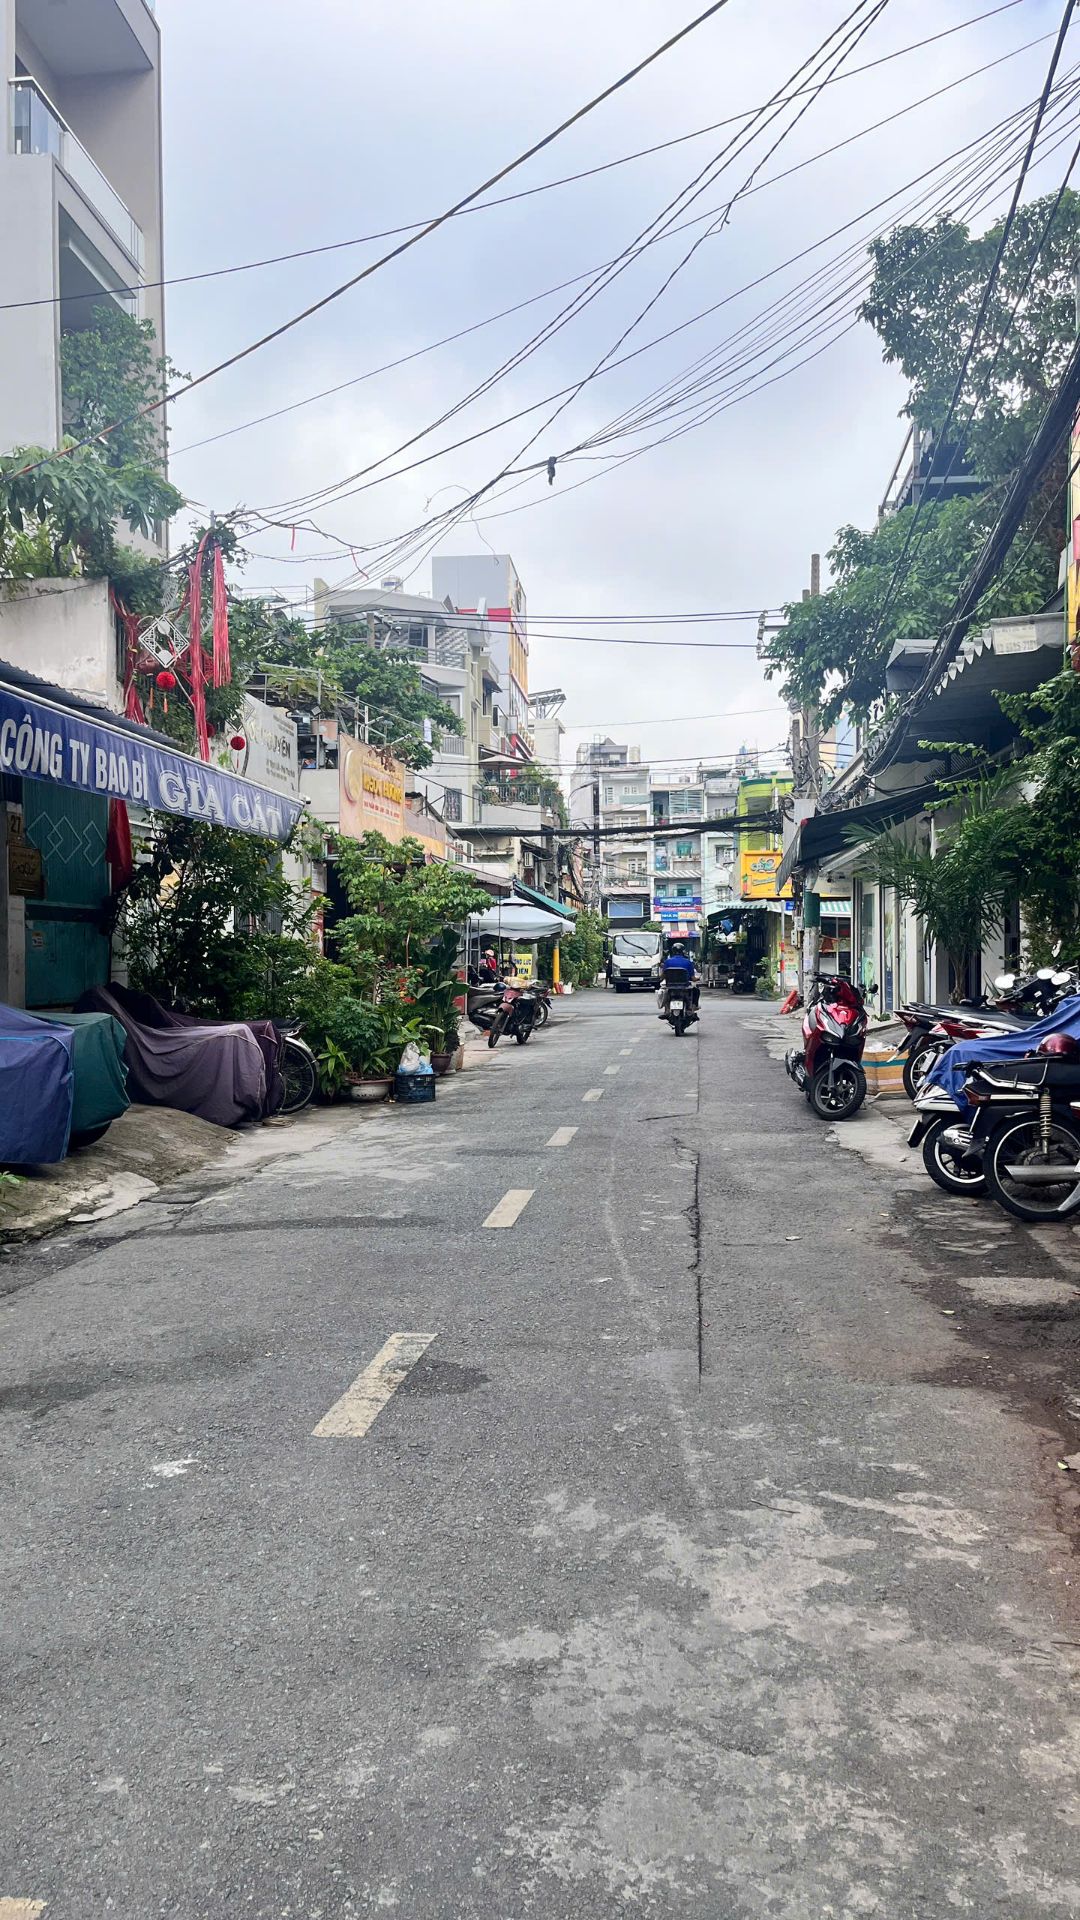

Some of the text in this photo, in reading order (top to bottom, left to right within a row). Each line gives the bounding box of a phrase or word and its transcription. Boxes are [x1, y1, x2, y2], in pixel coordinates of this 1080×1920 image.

[1, 714, 283, 836] CÔNG TY BAO BÌ GIA CÁT
[10, 814, 21, 834] 27
